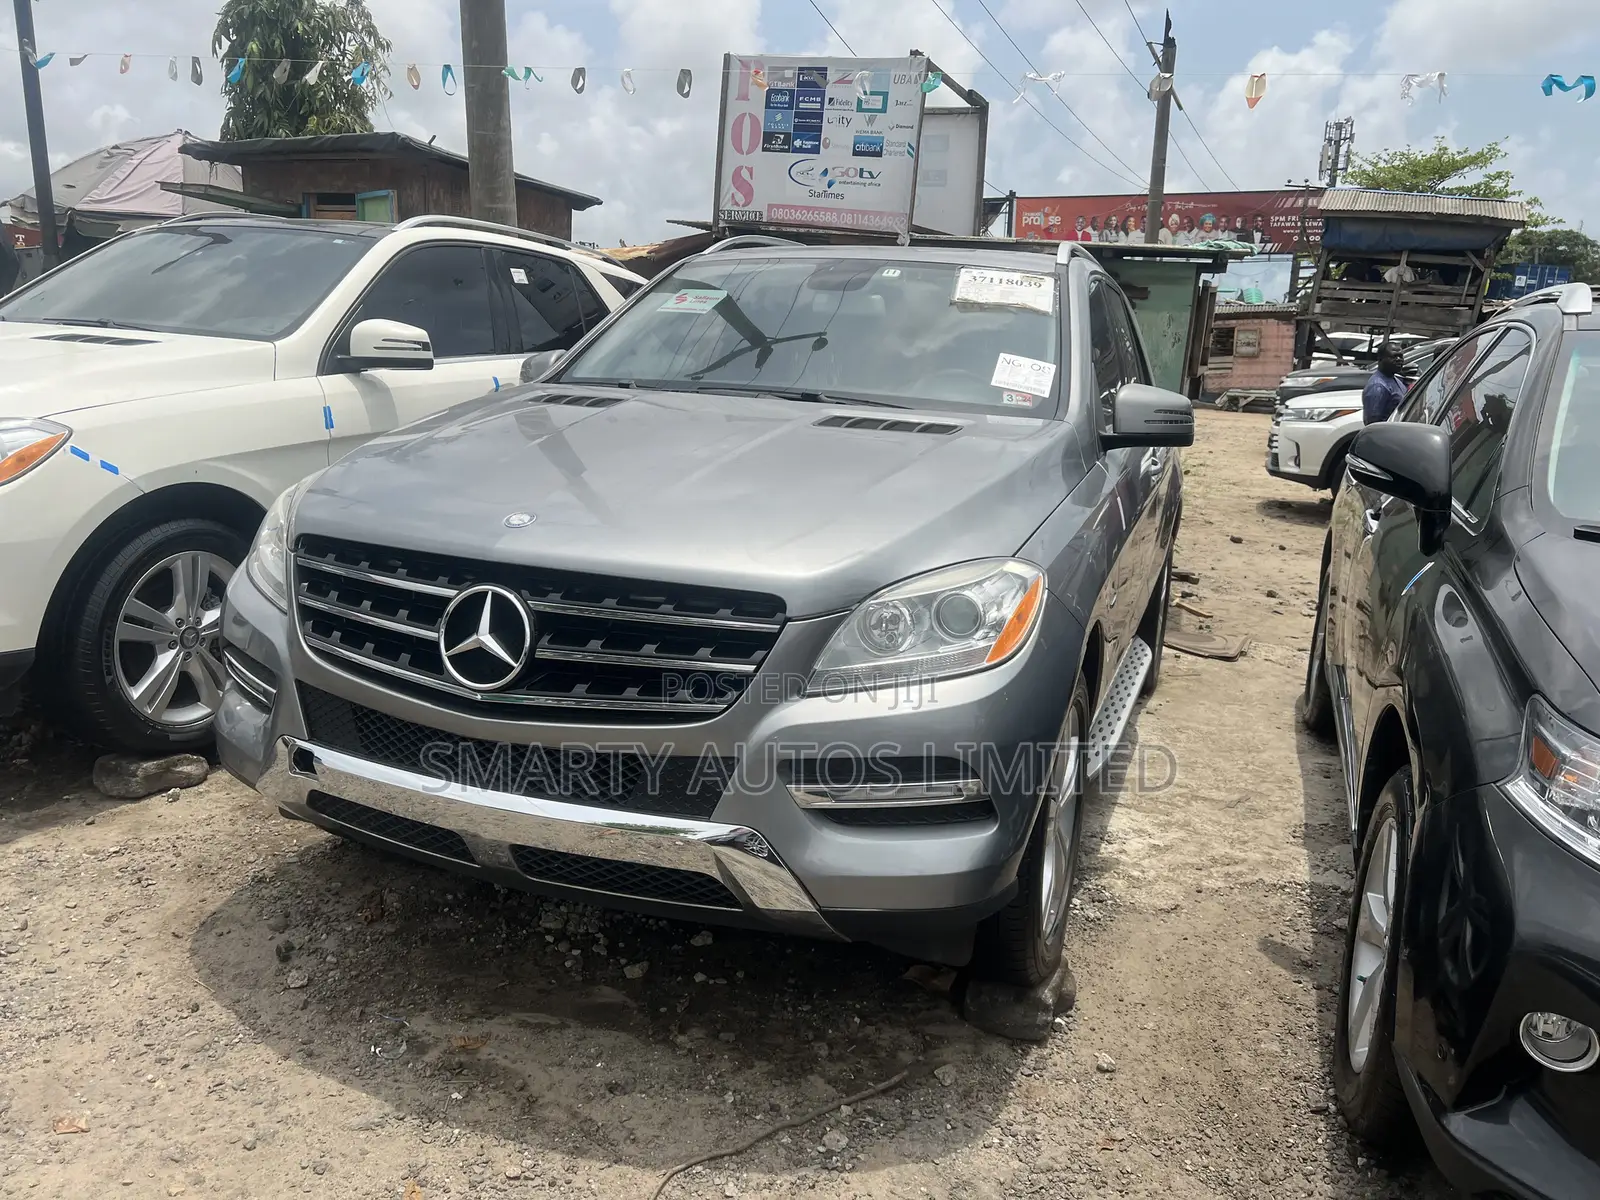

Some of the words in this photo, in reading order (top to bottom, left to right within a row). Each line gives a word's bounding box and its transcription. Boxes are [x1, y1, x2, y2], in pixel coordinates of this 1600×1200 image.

[893, 74, 912, 85] UBA
[885, 139, 907, 148] Standard
[883, 148, 906, 157] Chartered
[808, 189, 845, 200] StarTimes
[718, 209, 763, 222] SERVICE
[968, 275, 1042, 289] 37118039
[1006, 393, 1014, 402] 3
